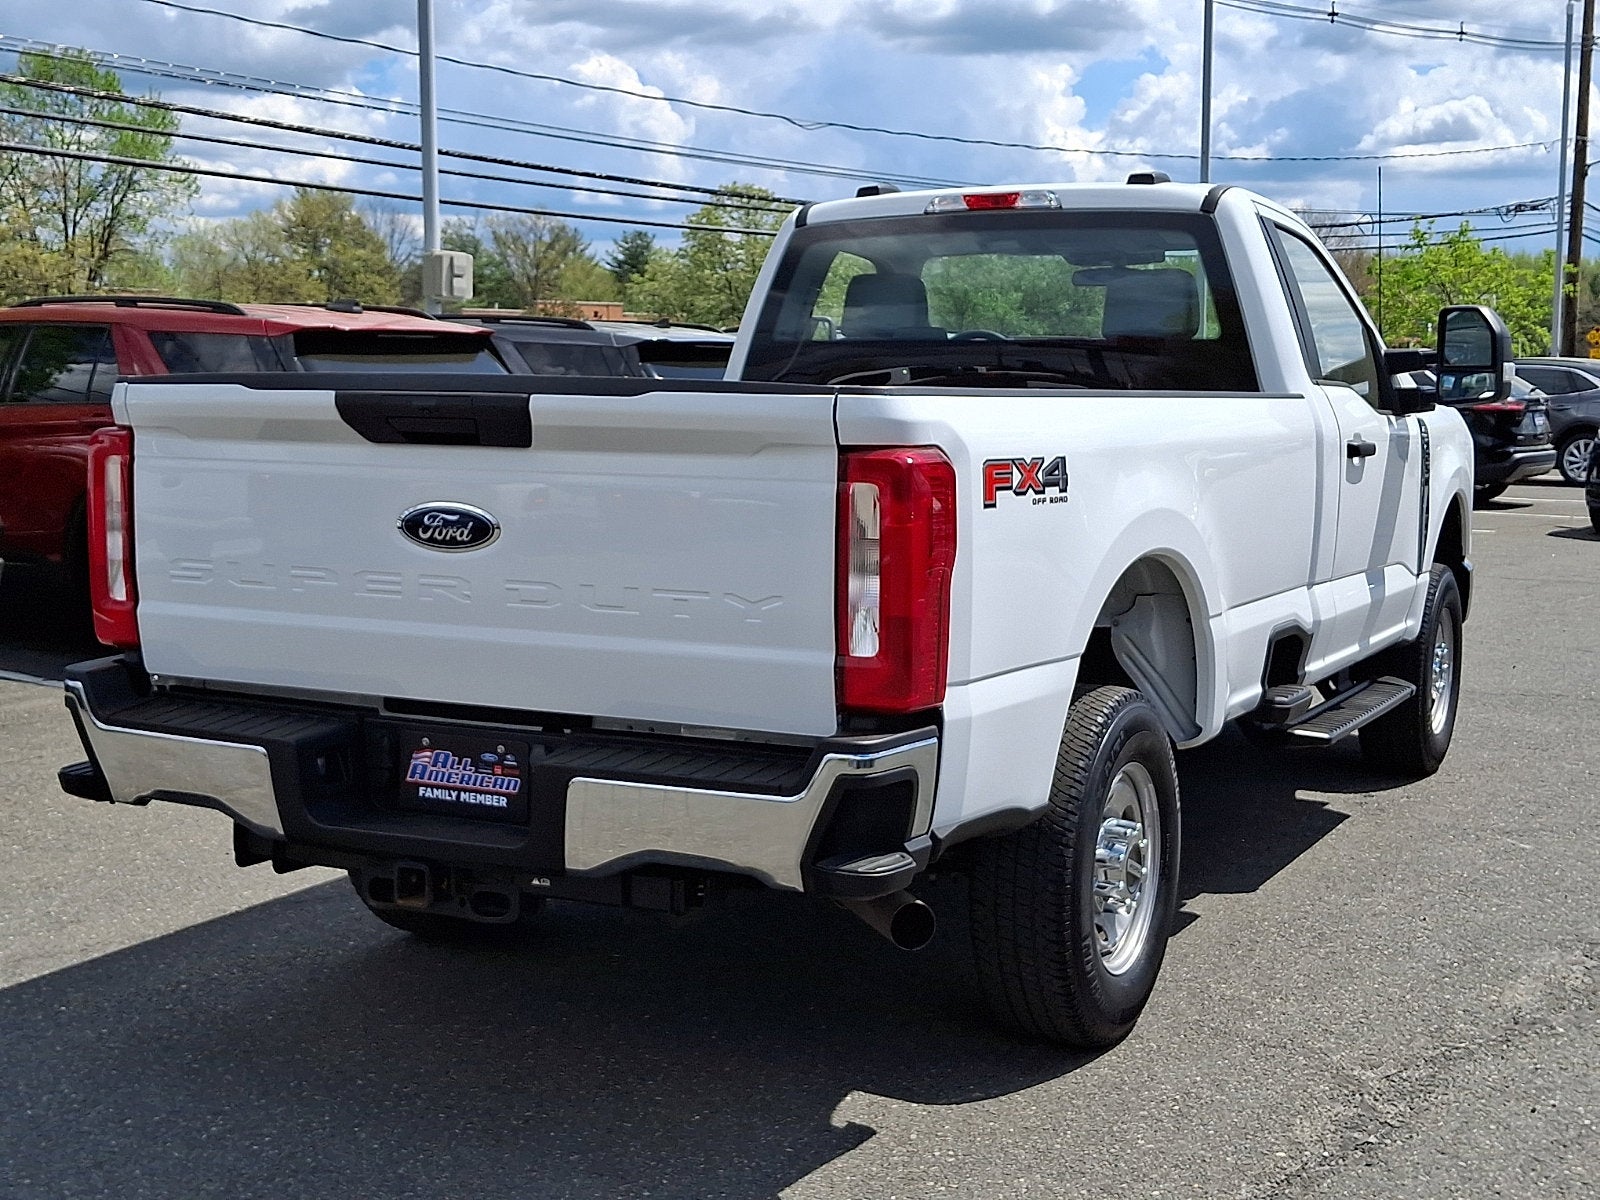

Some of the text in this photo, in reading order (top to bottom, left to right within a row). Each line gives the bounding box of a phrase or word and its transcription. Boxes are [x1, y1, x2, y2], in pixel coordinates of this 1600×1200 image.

[982, 455, 1069, 509] FX4
[1032, 495, 1068, 506] OFF ROAD
[418, 511, 474, 541] Ford
[169, 557, 784, 623] SUPER DUTY
[419, 787, 507, 807] FAMILY MEMBER
